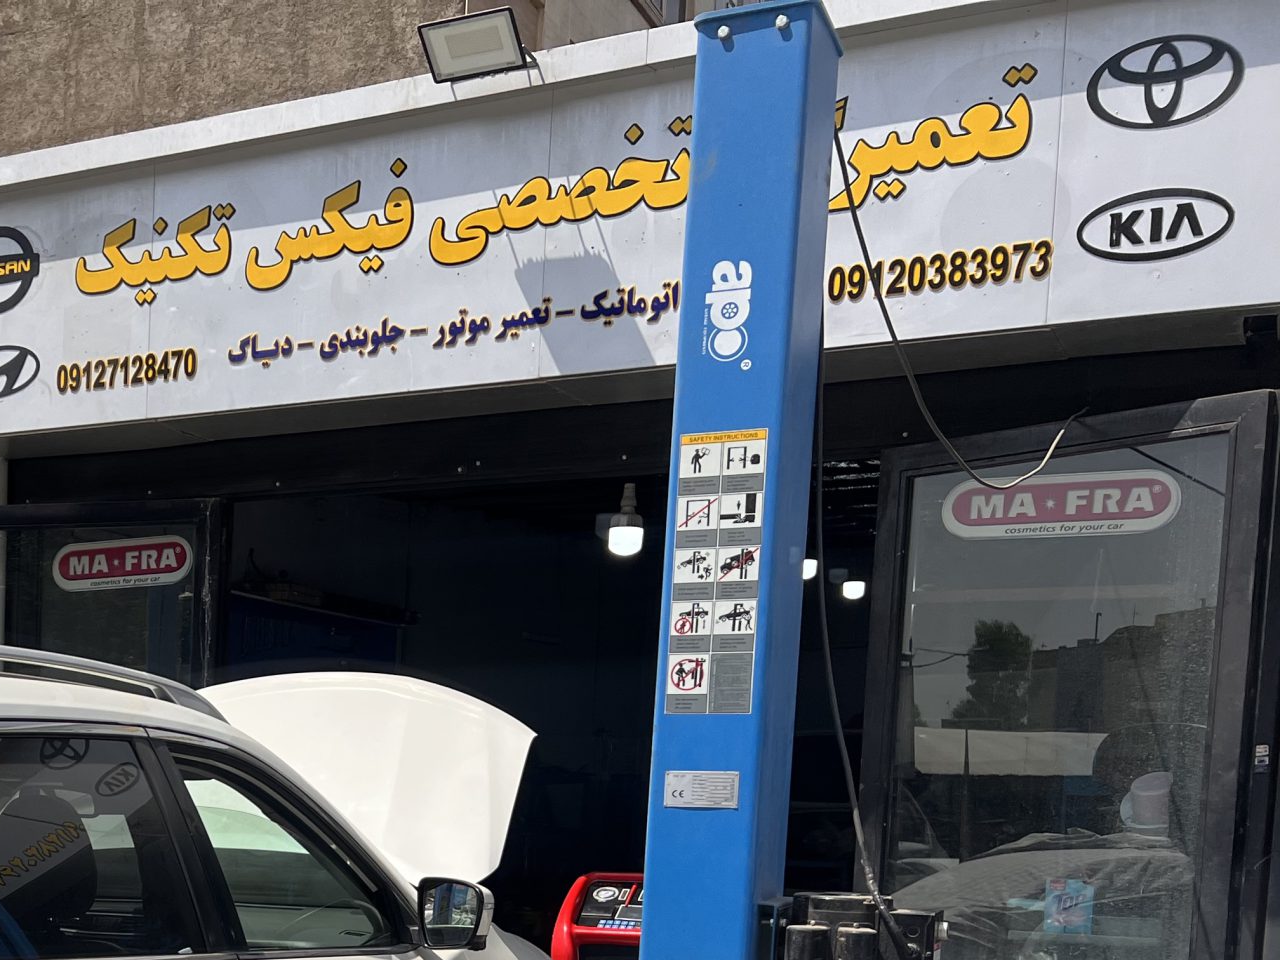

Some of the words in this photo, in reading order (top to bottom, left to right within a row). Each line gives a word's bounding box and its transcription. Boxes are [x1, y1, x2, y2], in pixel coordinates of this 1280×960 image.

[245, 158, 414, 291] فیکس
[1109, 202, 1204, 248] KIA
[75, 203, 236, 305] تکنیک
[827, 239, 1055, 303] 09120383973
[495, 296, 553, 340] تعمیر
[580, 280, 681, 327] اتوماتیک
[319, 317, 406, 362] جلوبندی
[432, 308, 490, 348] موتور
[56, 347, 199, 395] 09127128470
[689, 435, 712, 443] SAFETY
[1004, 525, 1057, 535] cosmetics
[1059, 523, 1076, 532] for
[1077, 524, 1105, 534] your
[1107, 522, 1124, 530] car
